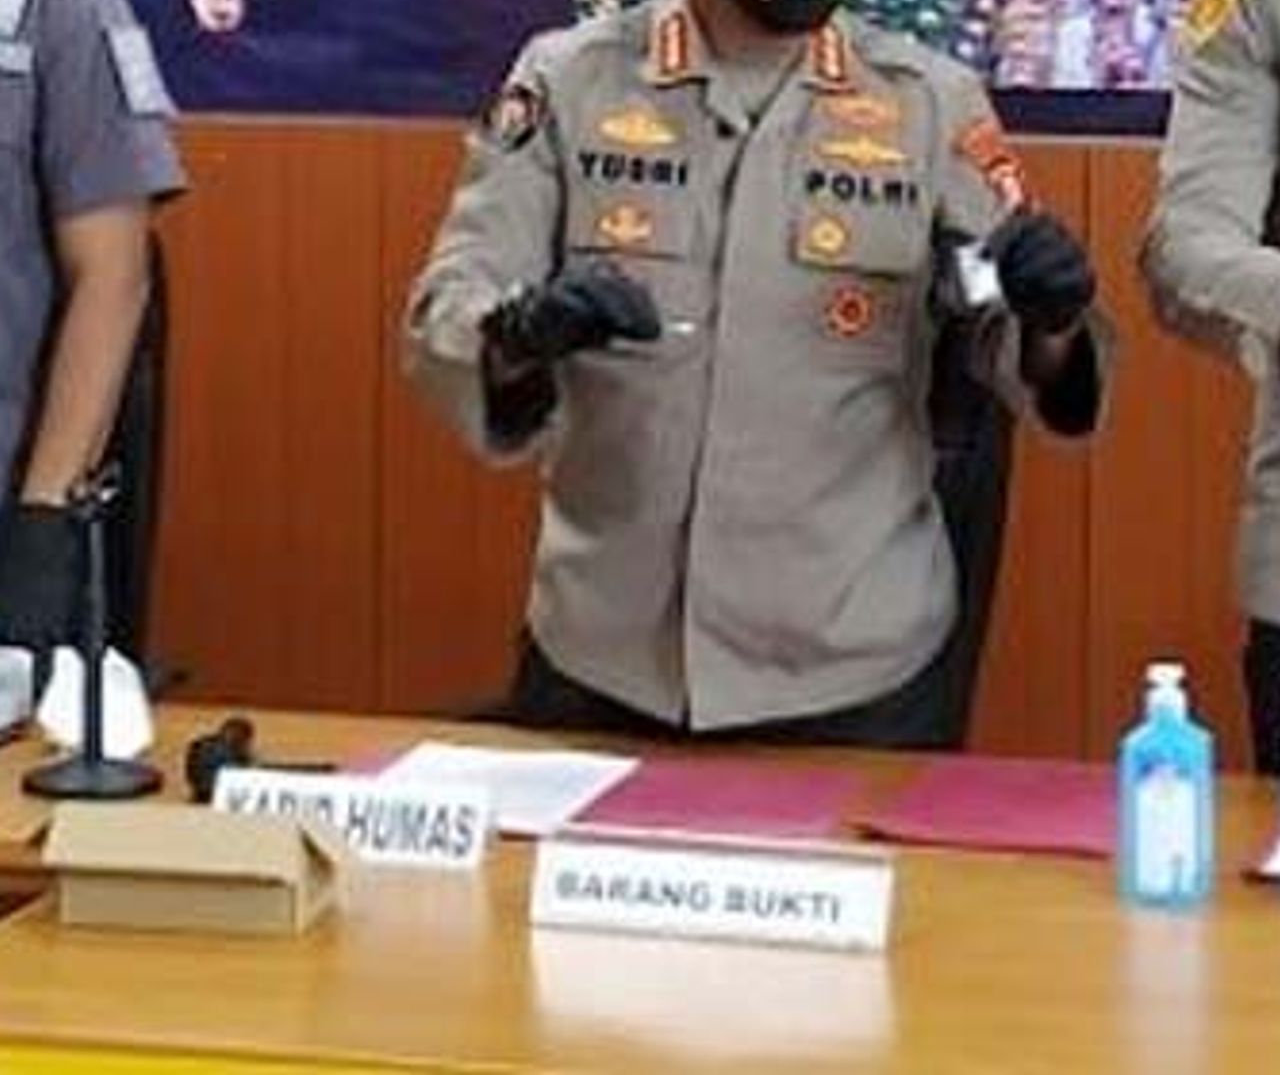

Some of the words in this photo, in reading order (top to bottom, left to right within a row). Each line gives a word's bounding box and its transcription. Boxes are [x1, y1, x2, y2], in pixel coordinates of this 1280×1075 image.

[805, 169, 919, 207] POLRI
[344, 791, 478, 857] HUMAS
[555, 871, 711, 912] BARANG
[724, 884, 842, 924] BUKTI
